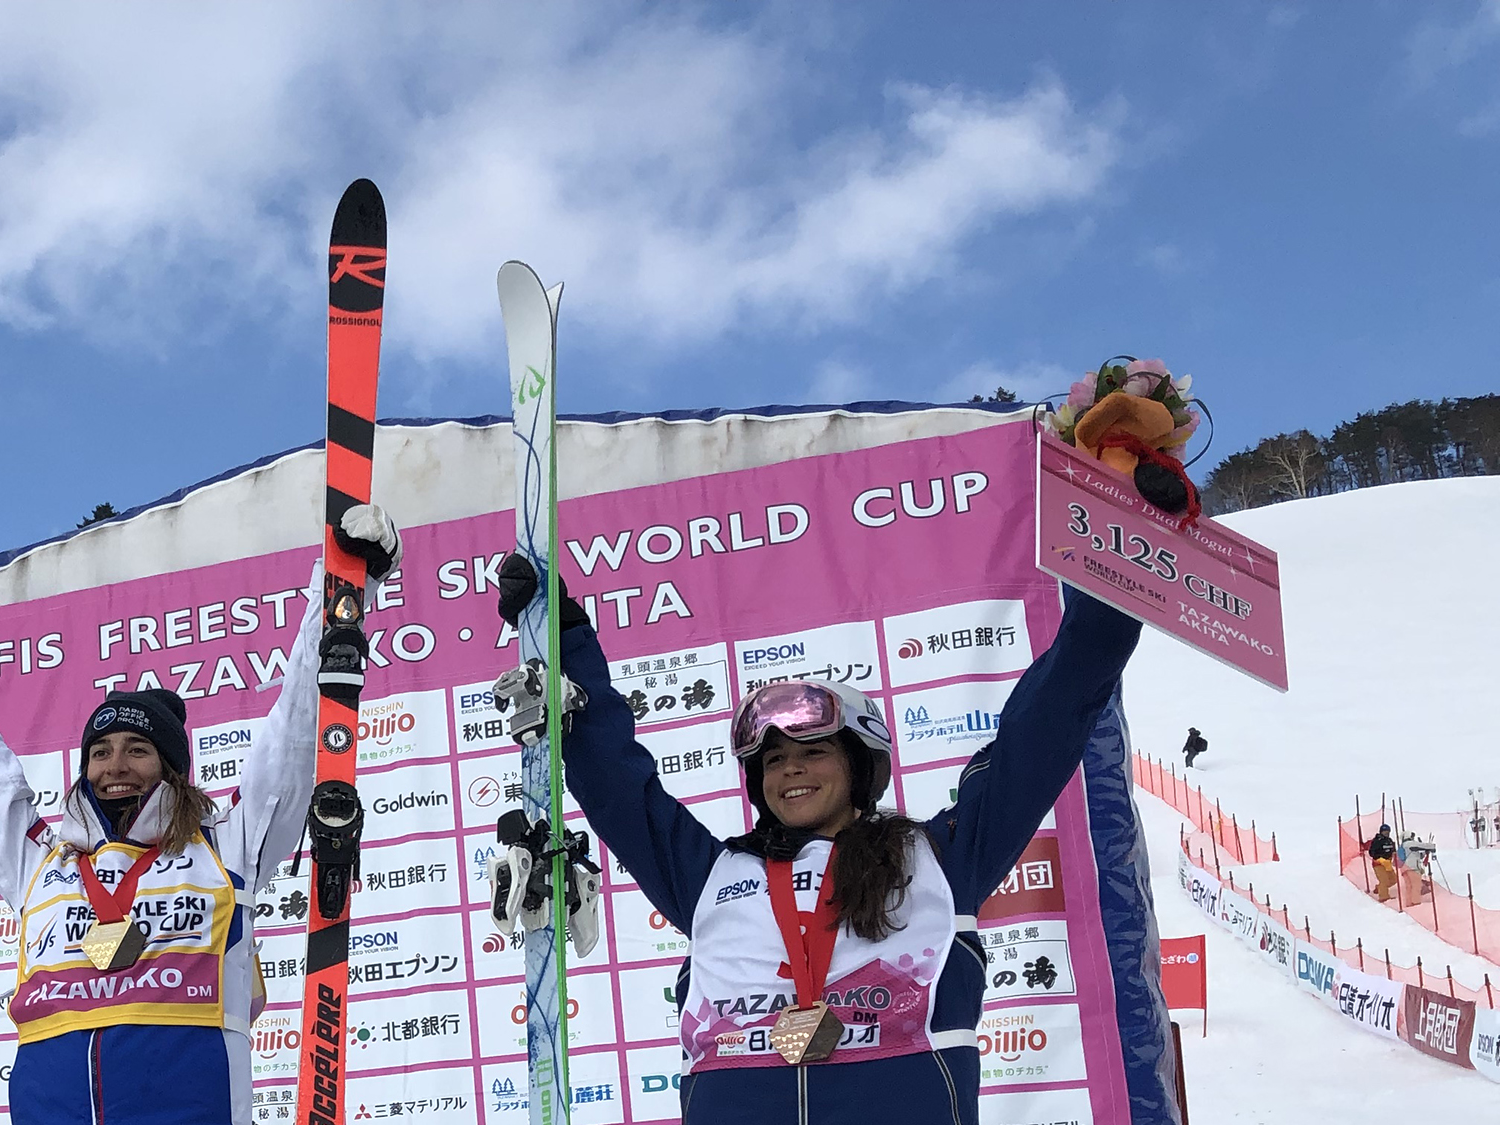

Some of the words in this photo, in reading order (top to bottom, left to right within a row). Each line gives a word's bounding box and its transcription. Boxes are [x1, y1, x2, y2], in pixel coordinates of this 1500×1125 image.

[328, 317, 382, 327] ROSSIGNOL
[1083, 473, 1139, 506] Ladies'
[1141, 503, 1181, 530] Dual
[1186, 523, 1234, 558] Mogul
[98, 568, 405, 660] FREESTE
[437, 550, 505, 600] SK
[566, 503, 810, 577] WORLD
[851, 471, 990, 527] CUP
[1067, 501, 1179, 583] 3,125
[1181, 573, 1253, 621] CHF
[1083, 556, 1146, 593] FREESTYLE
[1147, 588, 1167, 604] SKI
[1084, 562, 1117, 585] WORLD
[1116, 578, 1136, 594] CUP
[927, 626, 1016, 655] 秋田銀行
[1178, 614, 1230, 646] AKITA
[94, 623, 436, 701] TAZAWKO
[621, 652, 698, 676] 乳頭温泉郷
[743, 642, 805, 665] EPSON
[362, 701, 404, 718] NISSHIN
[199, 729, 251, 750] EPSON
[373, 790, 448, 815] Goldwin
[366, 863, 447, 891] 秋田銀行
[716, 878, 760, 901] EPSON
[173, 895, 206, 912] SKI
[159, 912, 204, 932] CUP
[347, 954, 458, 985] 秋田エプソン
[25, 967, 184, 1007] TAZAWAKO
[186, 984, 212, 997] DM
[381, 1014, 461, 1042] 北都銀行
[852, 1010, 878, 1023] DM
[981, 1014, 1034, 1030] NISSHIN
[258, 1106, 289, 1120] 秘湯
[374, 1096, 467, 1119] 三菱マテリアル
